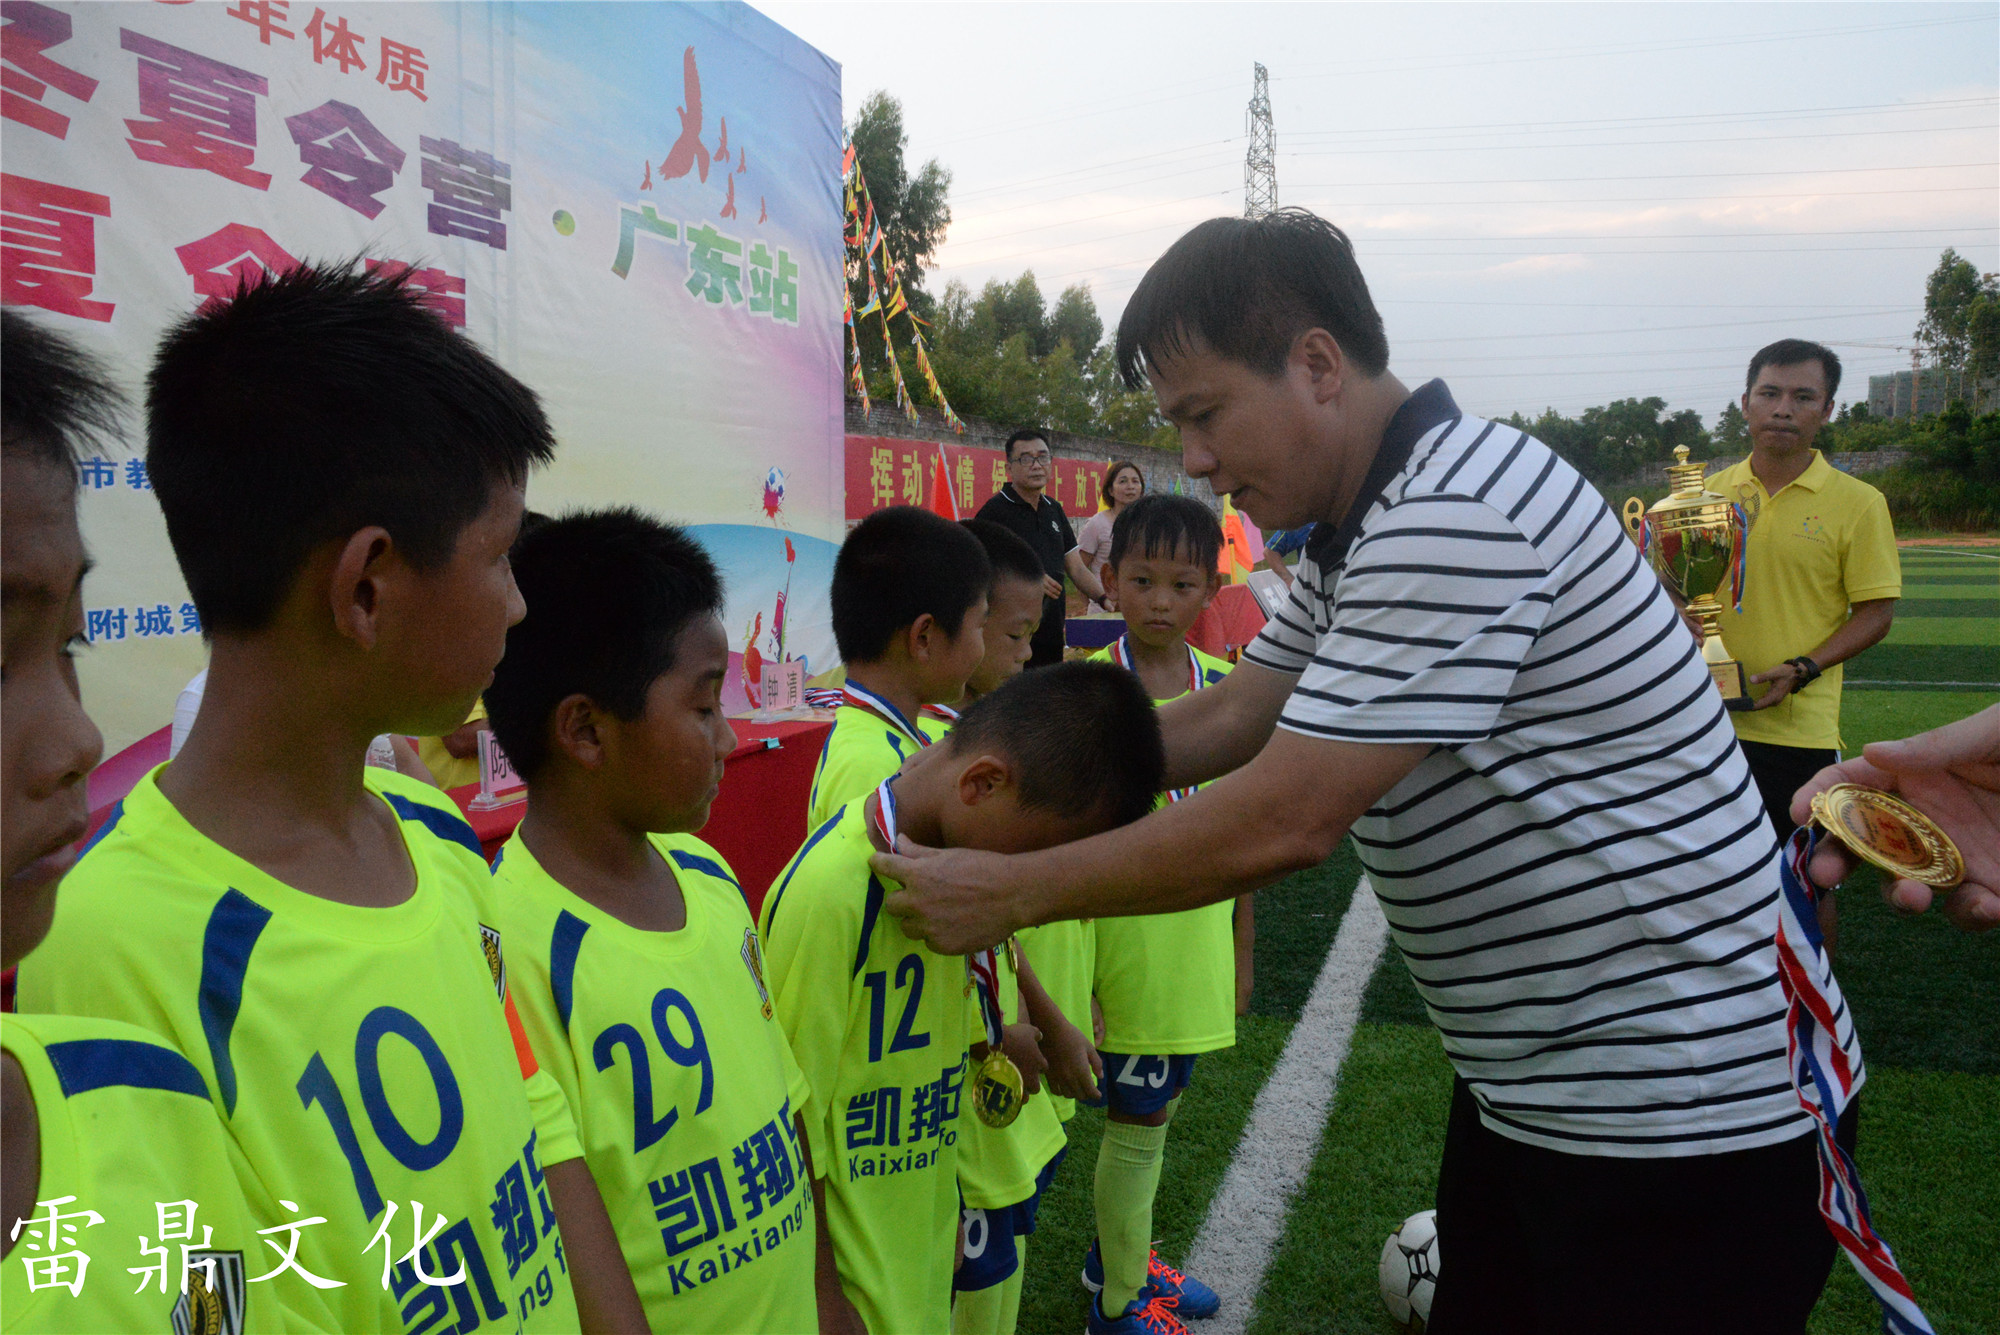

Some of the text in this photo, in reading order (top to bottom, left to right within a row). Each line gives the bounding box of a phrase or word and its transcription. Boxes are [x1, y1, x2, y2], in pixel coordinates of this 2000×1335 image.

[611, 204, 798, 323] 广东站
[863, 954, 931, 1063] 12
[296, 1006, 464, 1224] 10
[592, 988, 714, 1154] 29
[667, 1200, 802, 1296] Kaixiang
